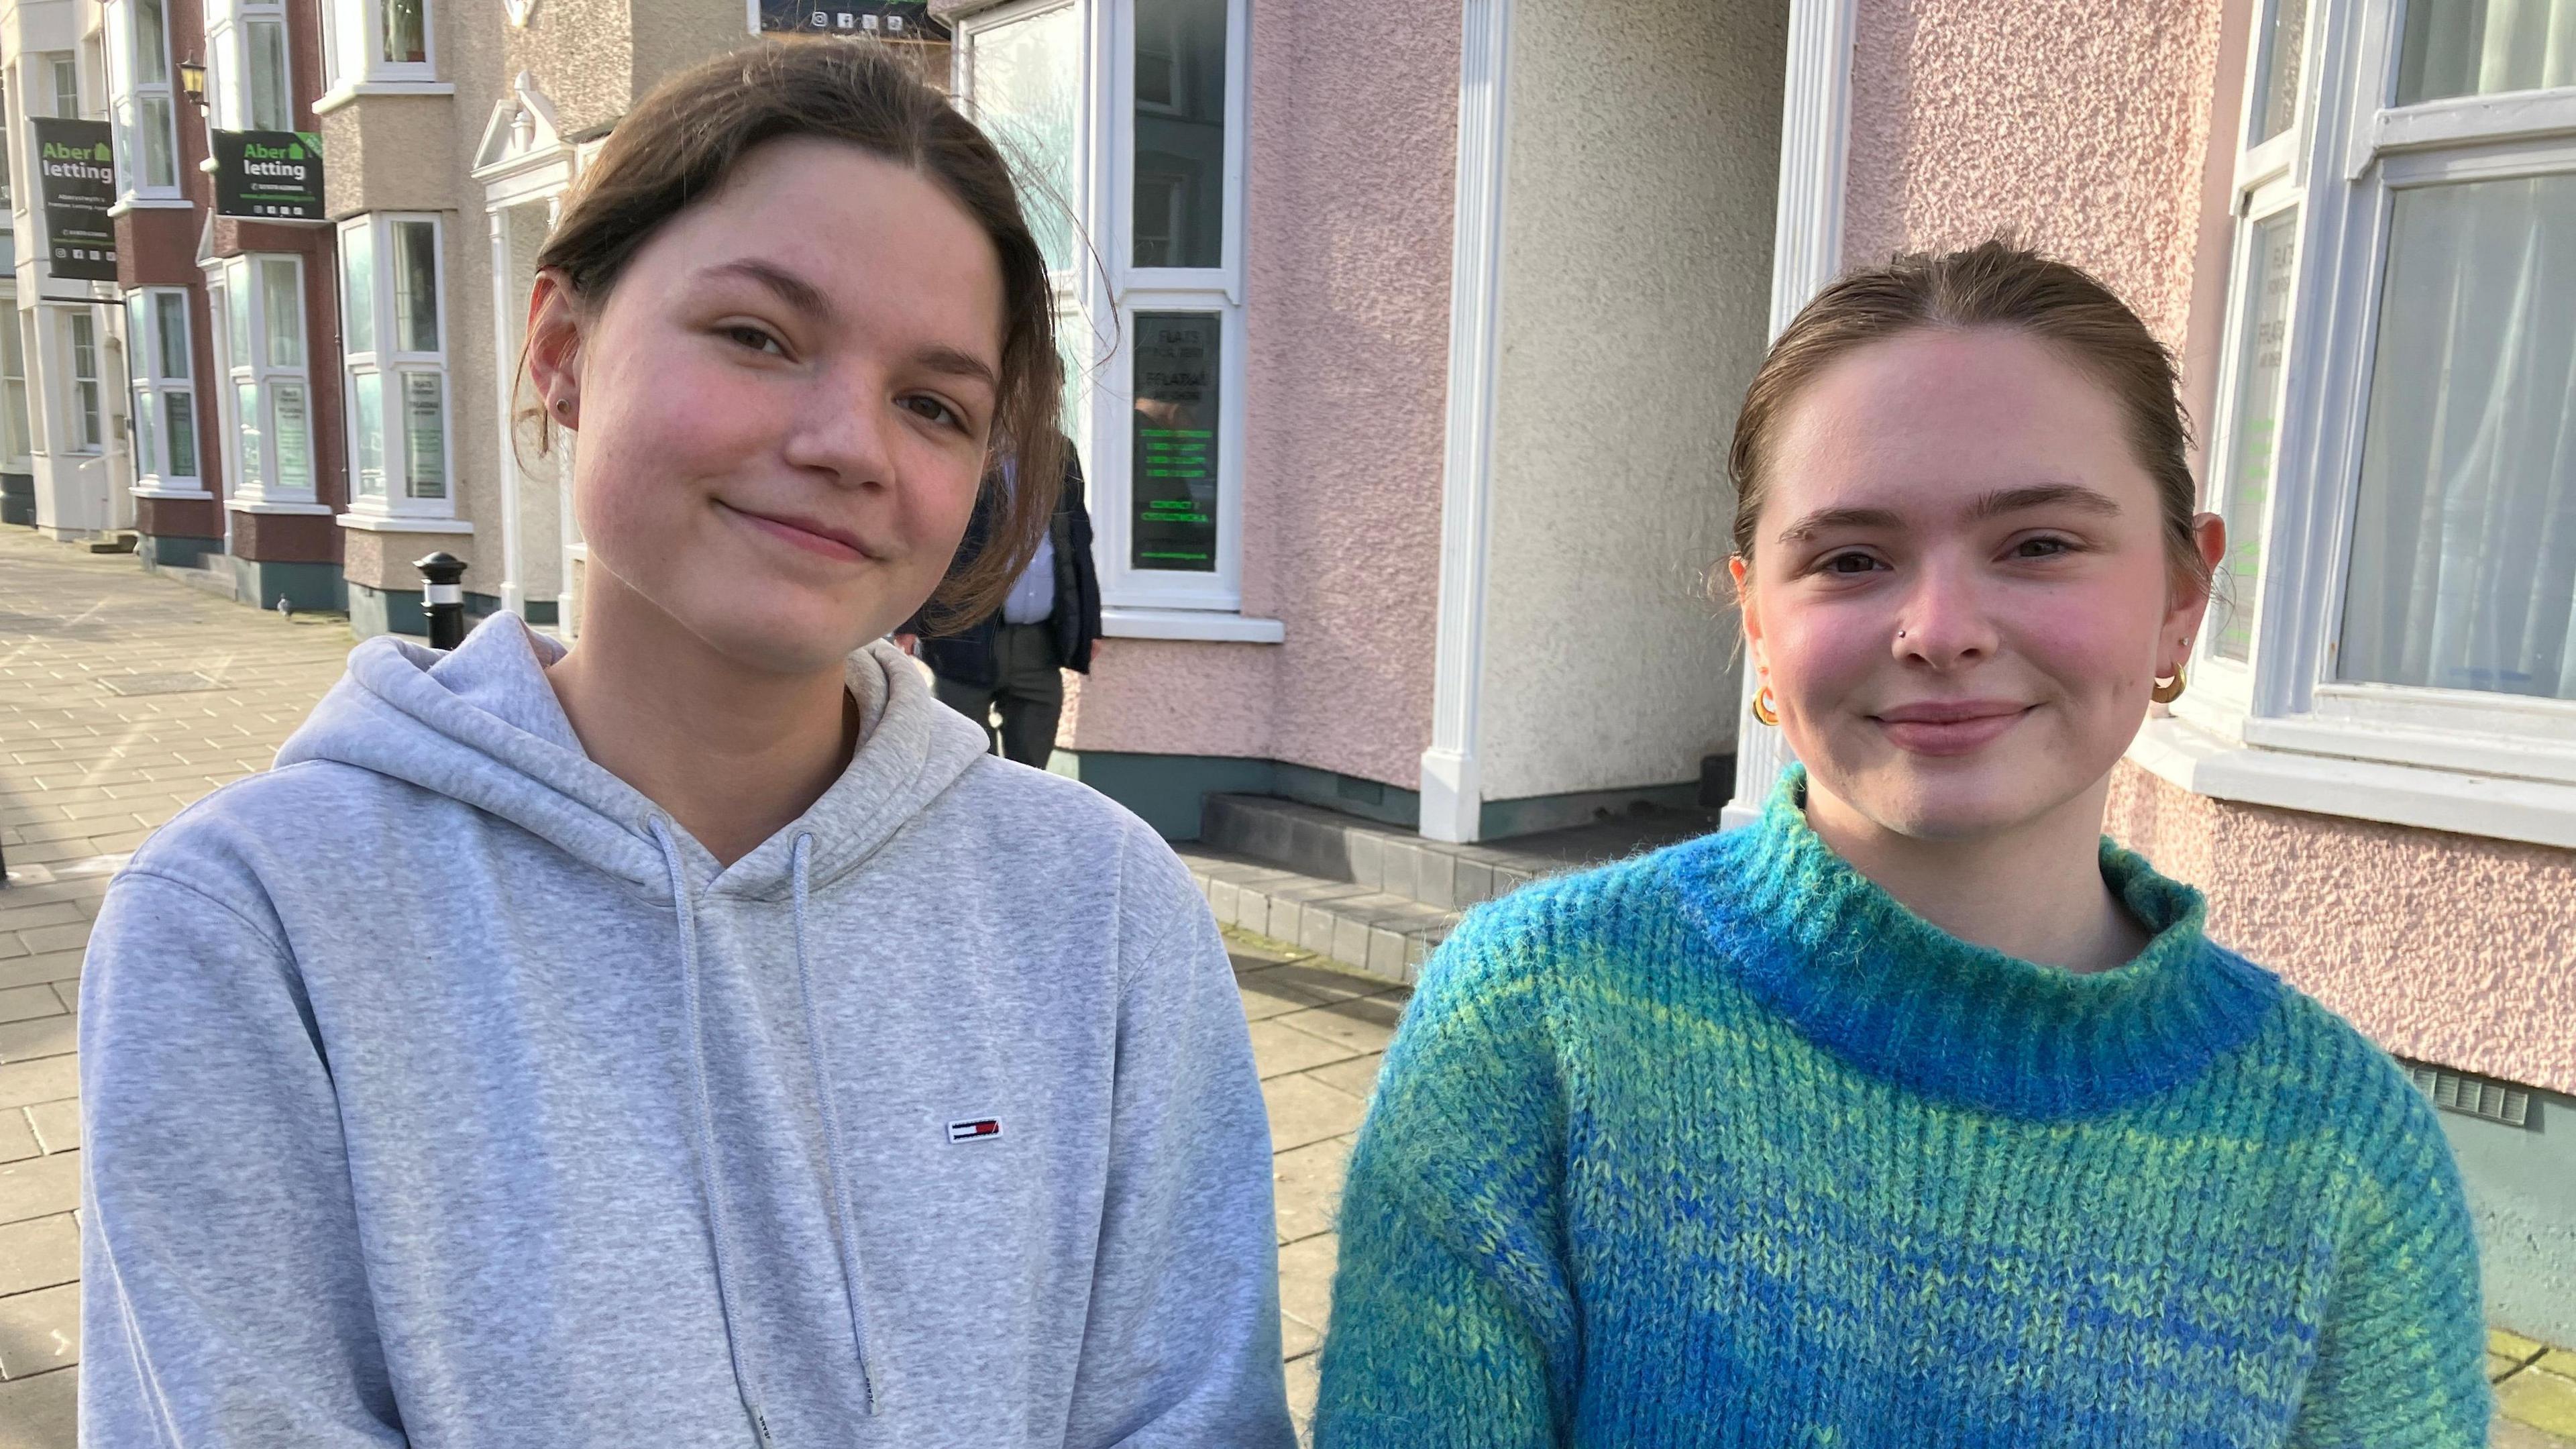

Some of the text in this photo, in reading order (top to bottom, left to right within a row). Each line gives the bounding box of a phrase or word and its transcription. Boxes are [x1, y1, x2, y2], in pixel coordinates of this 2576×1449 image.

[42, 142, 91, 160] Aber
[244, 143, 287, 159] Aber
[42, 160, 113, 184] letting
[244, 159, 306, 180] letting
